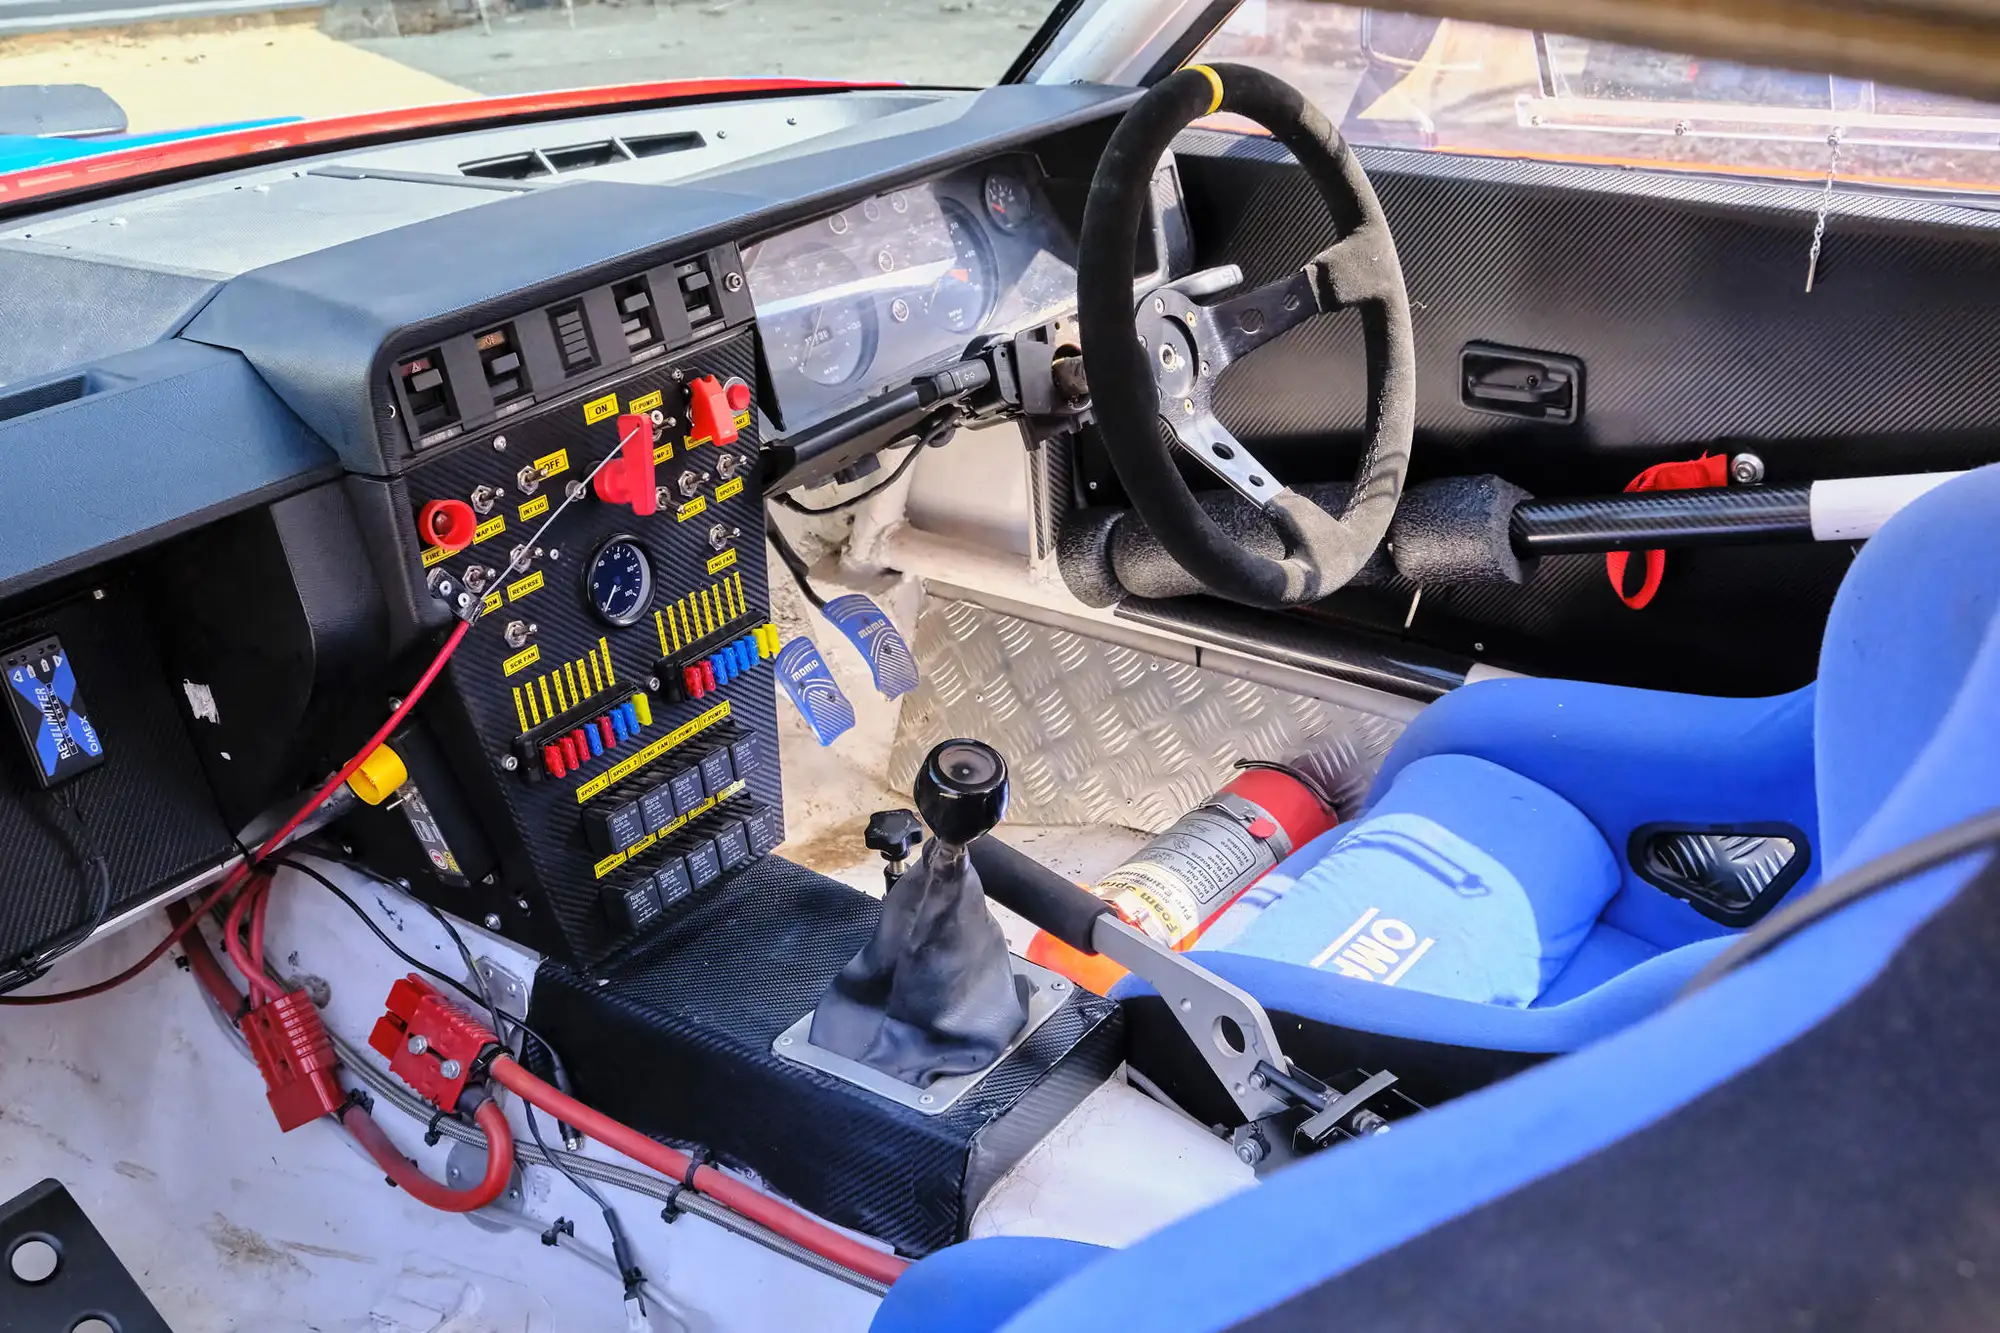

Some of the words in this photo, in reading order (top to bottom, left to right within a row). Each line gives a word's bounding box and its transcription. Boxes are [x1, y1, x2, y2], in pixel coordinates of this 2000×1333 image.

[595, 404, 608, 415] ON
[632, 399, 654, 412] F.PUMP
[543, 458, 560, 470] OFF
[720, 486, 736, 496] SPOTS
[523, 506, 534, 515] INT
[534, 502, 545, 510] LIG
[476, 526, 490, 538] MAP
[490, 522, 501, 532] LIG
[425, 552, 440, 562] FIRE
[711, 560, 722, 569] ENG
[723, 555, 733, 564] FAN
[626, 565, 634, 573] 80
[512, 578, 540, 596] REVERSE
[624, 588, 633, 597] 100
[510, 658, 523, 670] SCR
[524, 652, 536, 663] FAN
[791, 659, 819, 681] momo
[703, 711, 722, 724] F.PUMP
[79, 715, 99, 752] OMEX
[674, 728, 693, 742] F.PUMP
[643, 750, 655, 760] ENG
[656, 742, 668, 752] FAN
[613, 764, 632, 777] SPOTS
[581, 784, 599, 796] SPOTS
[660, 869, 674, 881] Ripca
[1197, 872, 1216, 890] Safety
[1211, 870, 1224, 884] Aim
[1192, 884, 1204, 900] Use
[1196, 880, 1210, 896] Pull
[630, 890, 645, 902] Ripca
[1140, 892, 1180, 934] Foam
